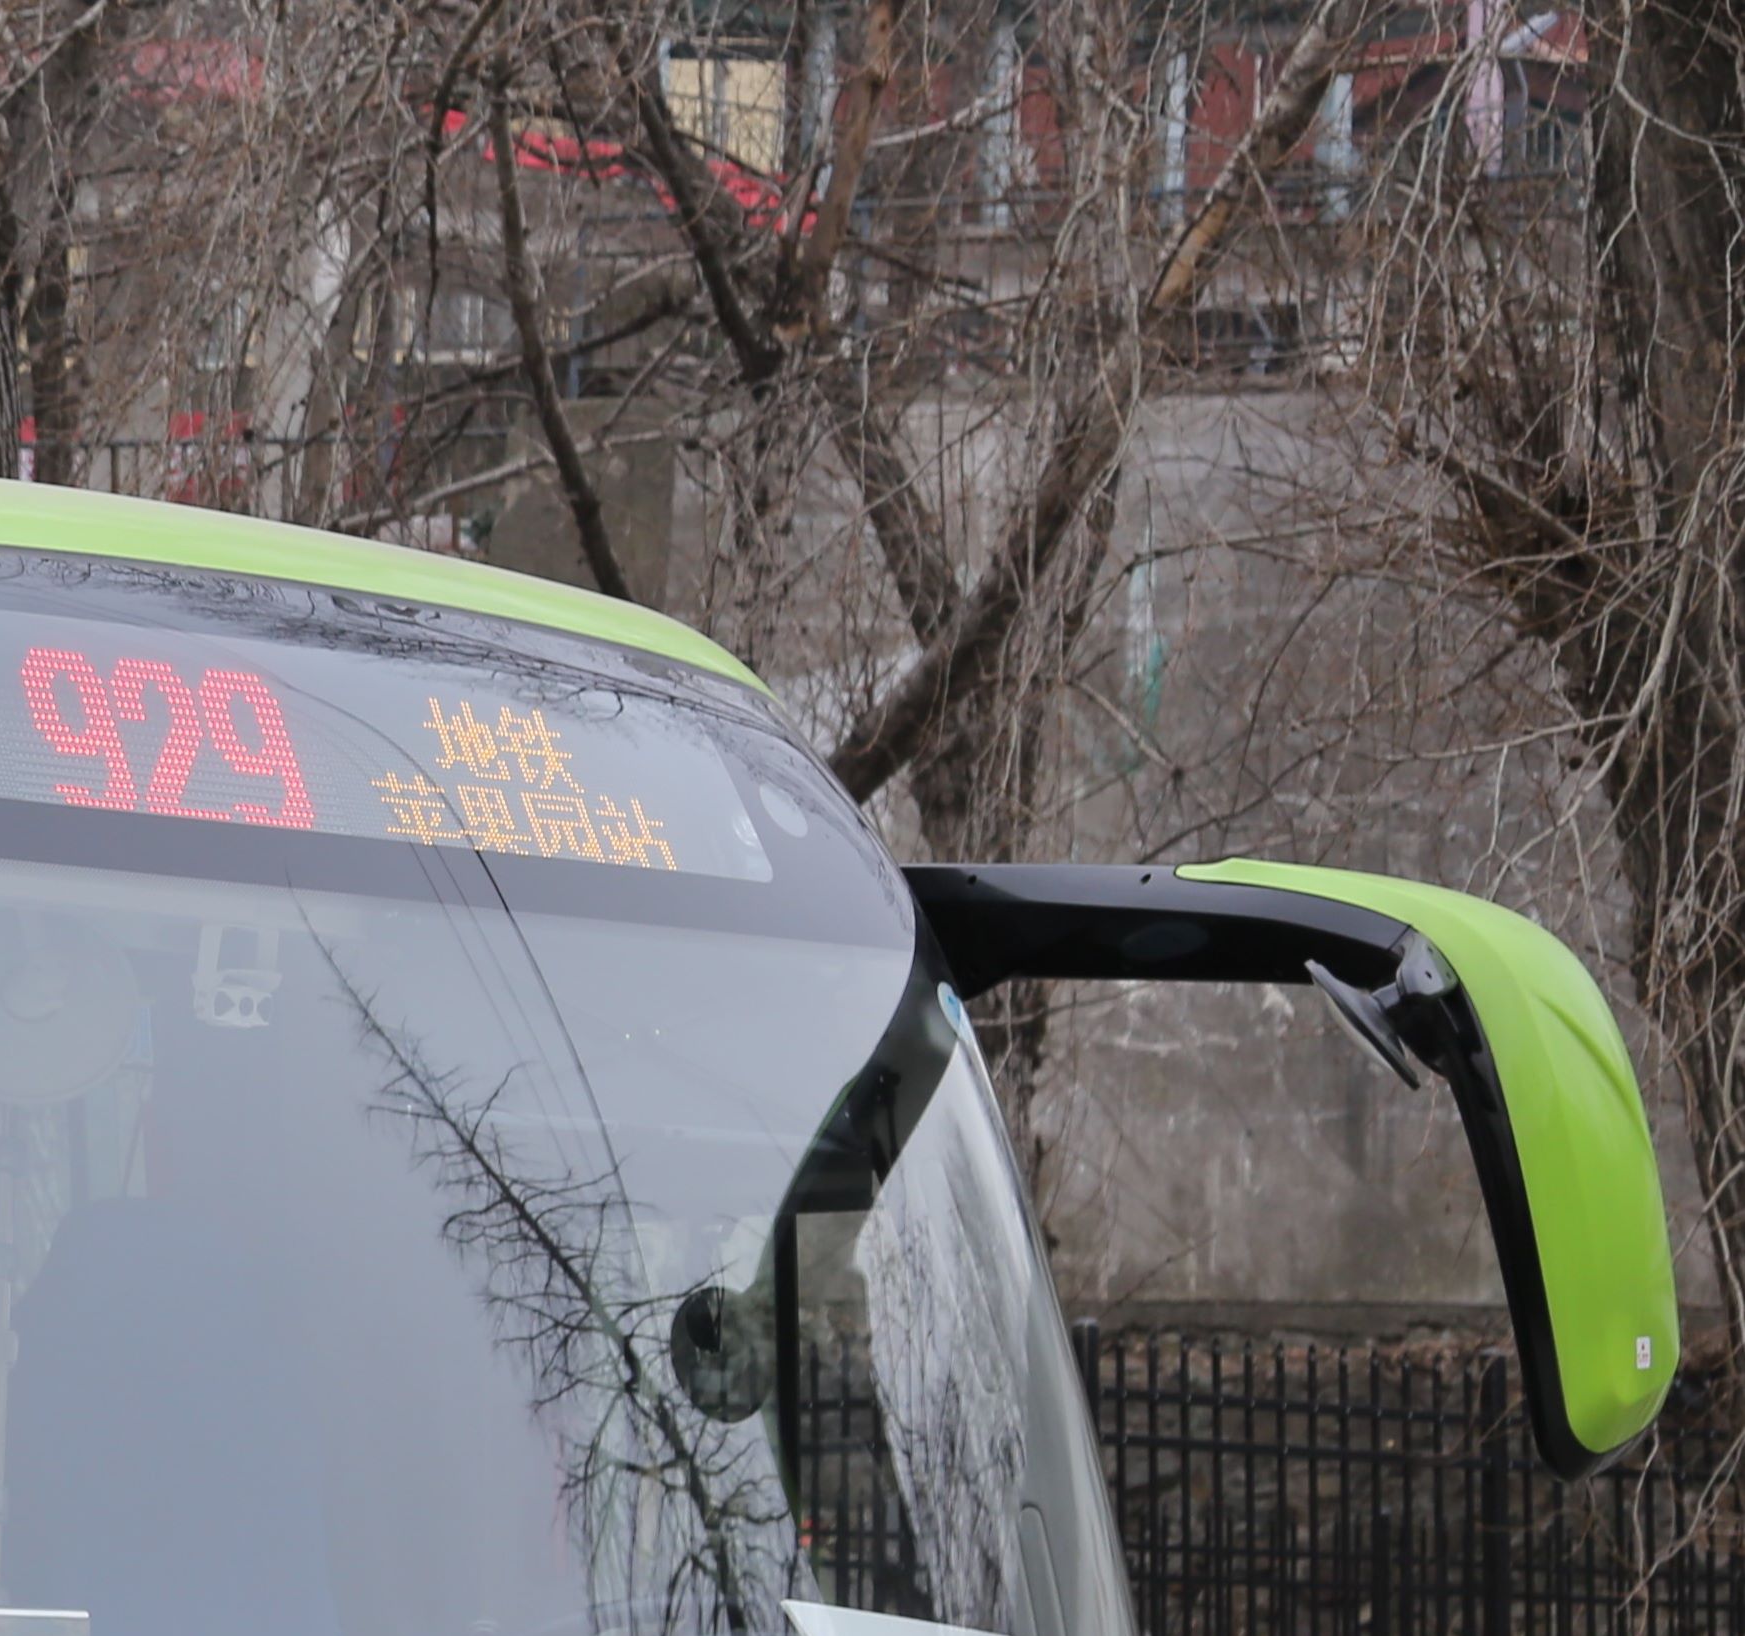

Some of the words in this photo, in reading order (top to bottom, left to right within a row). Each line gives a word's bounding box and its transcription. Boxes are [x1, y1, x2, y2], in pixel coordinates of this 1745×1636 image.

[21, 646, 313, 828] 929
[423, 697, 585, 794] 地铁
[372, 772, 677, 871] 苹果园站
